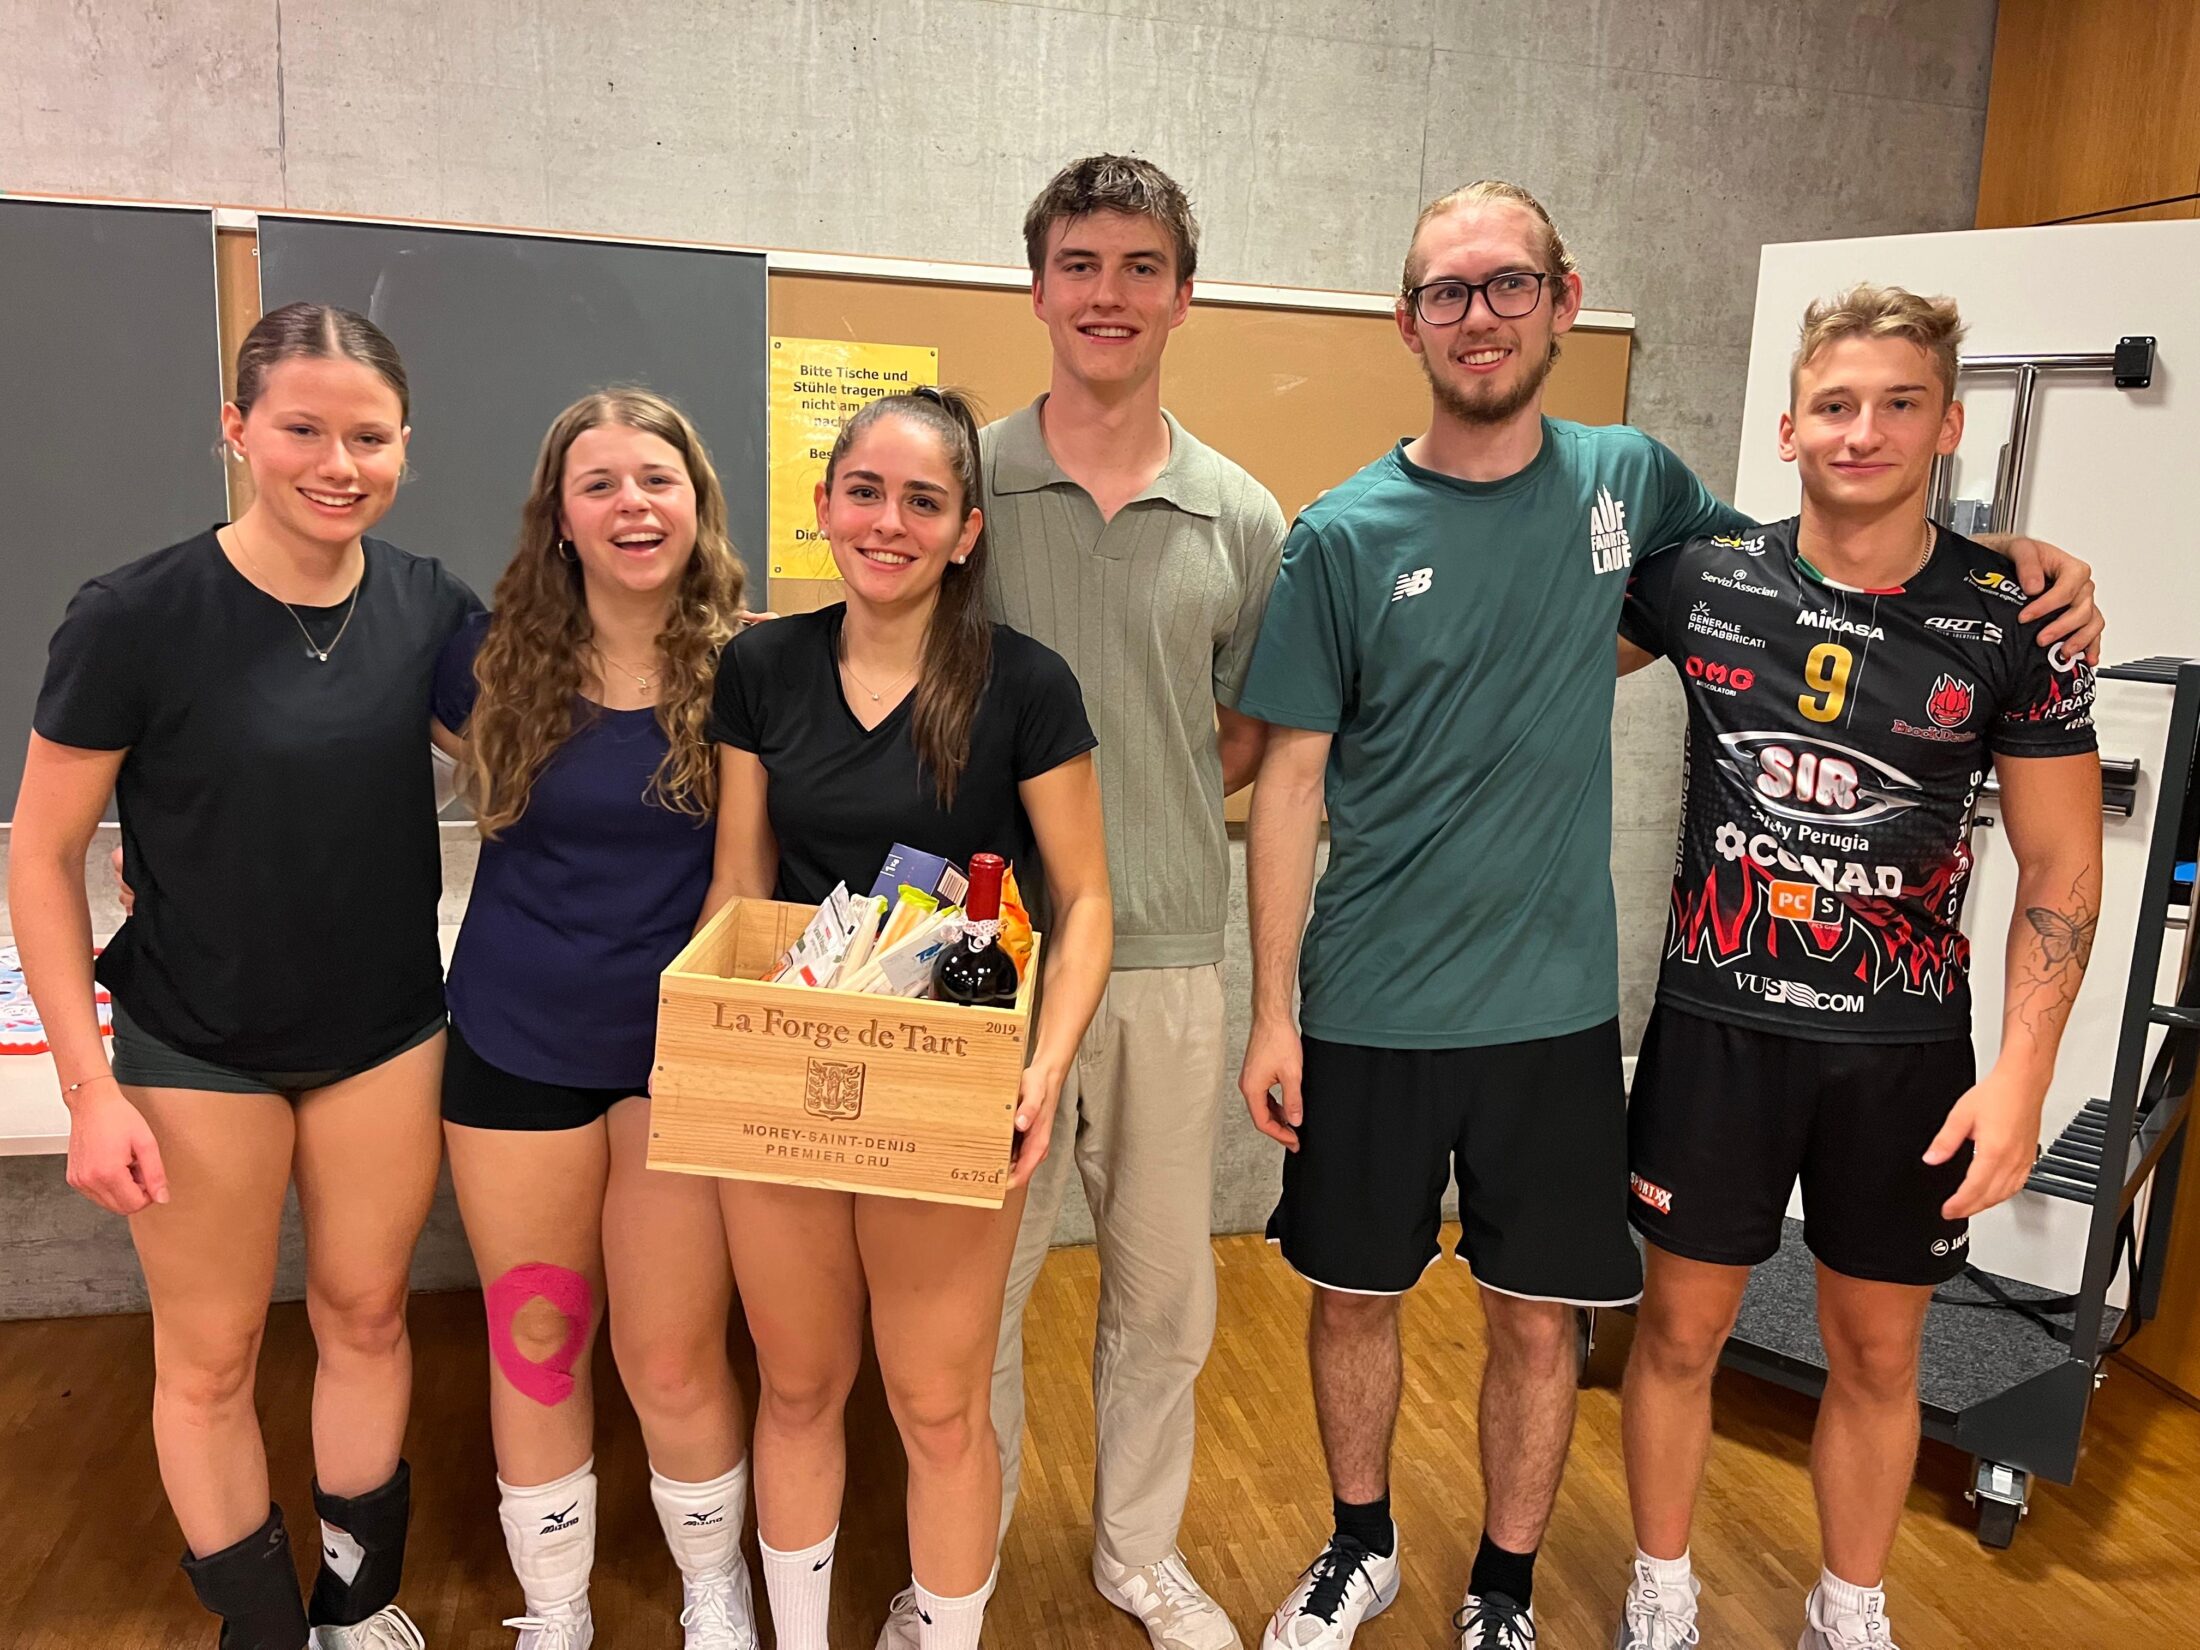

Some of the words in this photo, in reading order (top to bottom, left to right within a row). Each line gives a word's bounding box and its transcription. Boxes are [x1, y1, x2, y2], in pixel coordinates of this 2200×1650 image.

[800, 365, 833, 377] Bitte
[836, 367, 879, 380] Tische
[883, 371, 908, 381] und
[793, 382, 837, 394] Stühle
[841, 385, 885, 398] tragen
[802, 399, 836, 411] nicht
[840, 403, 860, 412] am
[809, 448, 834, 460] Bes
[1590, 483, 1626, 536] AUF
[796, 530, 818, 541] Die
[1590, 529, 1630, 552] FAHRTS
[1592, 543, 1633, 575] LAUF
[1701, 571, 1733, 588] Servizi
[1732, 581, 1779, 598] Associati
[1687, 621, 1767, 649] PREFABBRICATI
[1689, 612, 1742, 634] GENERALE
[1924, 617, 1982, 631] ART
[1798, 642, 1853, 722] 9
[1756, 746, 1858, 810] SIR
[1798, 824, 1870, 852] Perugia
[1815, 992, 1864, 1013] COM
[711, 1001, 752, 1033] La
[762, 1007, 850, 1049] Forge
[858, 1018, 895, 1049] de
[900, 1022, 968, 1057] Tart
[985, 1022, 1017, 1035] 2019
[742, 1123, 917, 1153] MOREY-SAINT-DENIS
[765, 1143, 846, 1164] PREMIER
[854, 1154, 890, 1168] CRU
